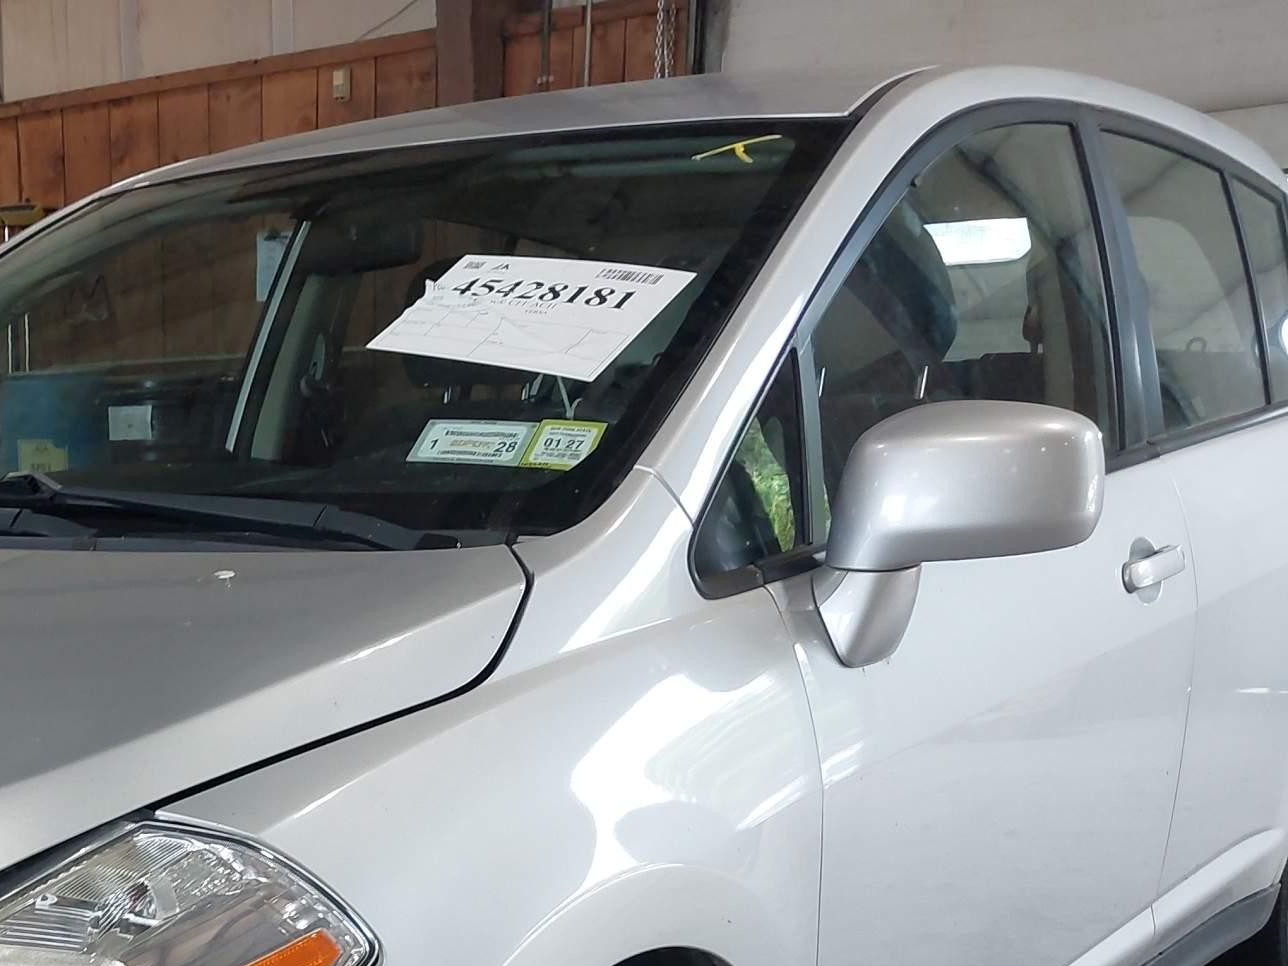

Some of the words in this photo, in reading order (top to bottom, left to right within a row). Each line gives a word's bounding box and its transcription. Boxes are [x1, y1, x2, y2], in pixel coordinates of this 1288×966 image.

[452, 277, 637, 310] 45428181
[430, 438, 439, 451] 1
[493, 440, 518, 454] 28
[543, 437, 562, 449] 01
[566, 438, 585, 450] 27
